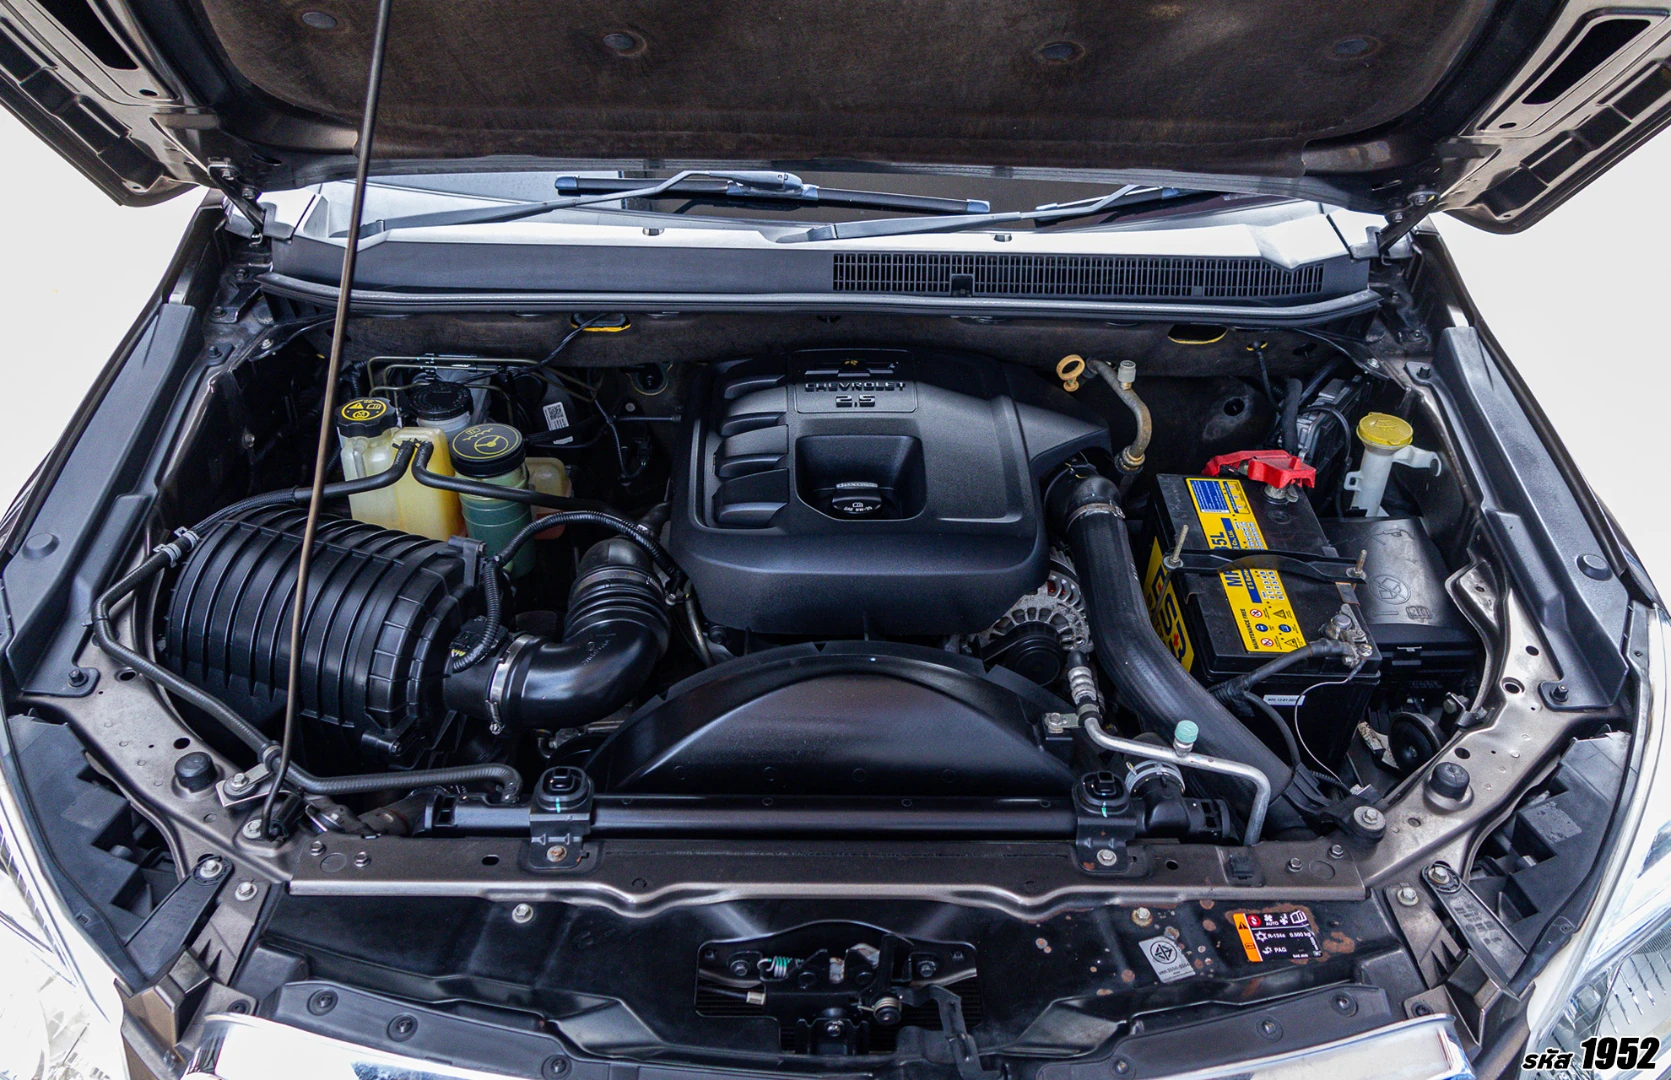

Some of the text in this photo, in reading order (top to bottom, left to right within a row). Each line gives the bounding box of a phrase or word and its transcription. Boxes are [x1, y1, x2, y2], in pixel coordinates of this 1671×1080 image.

[804, 381, 906, 392] CHEVROLET
[835, 394, 876, 408] 2.5
[1244, 619, 1260, 650] MAINTENANCE
